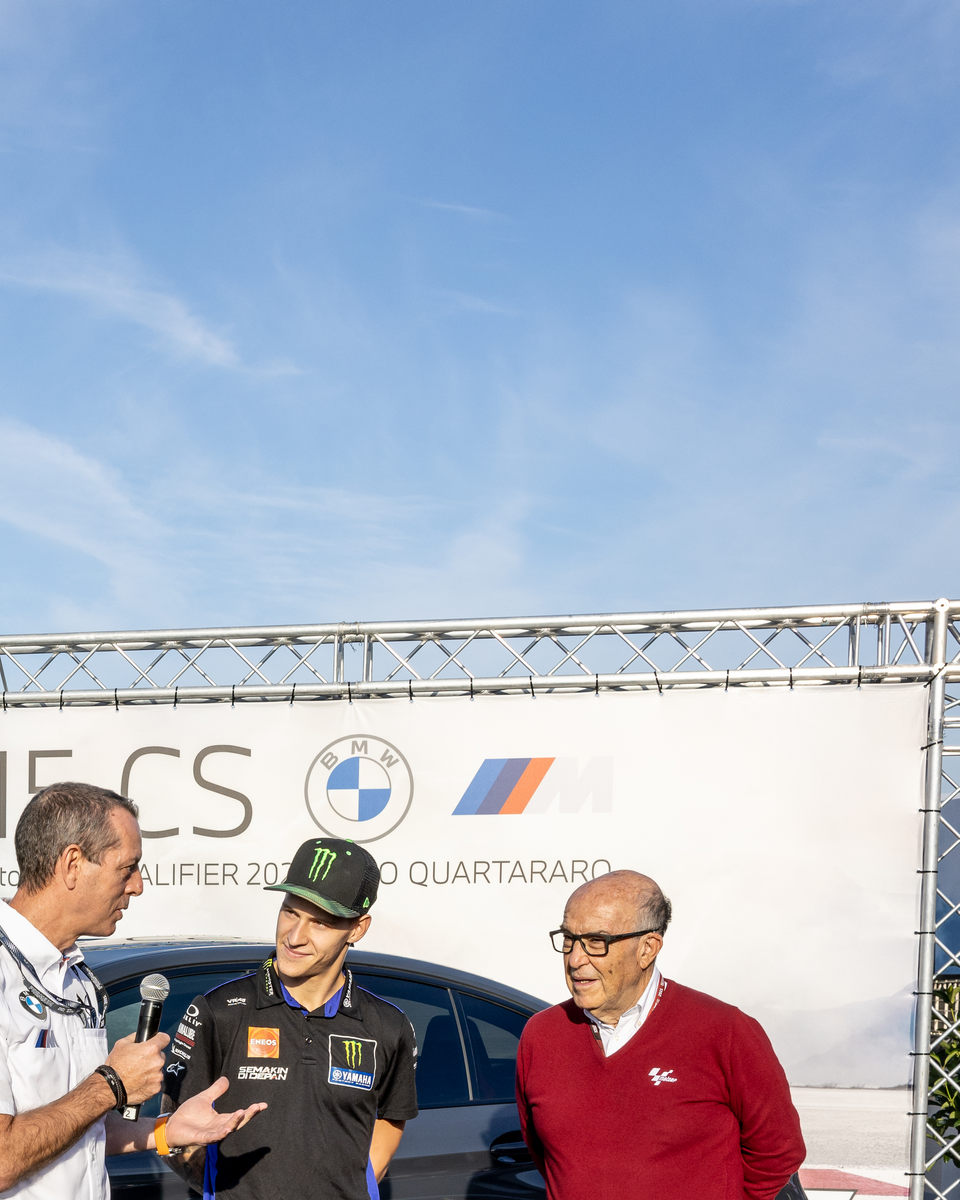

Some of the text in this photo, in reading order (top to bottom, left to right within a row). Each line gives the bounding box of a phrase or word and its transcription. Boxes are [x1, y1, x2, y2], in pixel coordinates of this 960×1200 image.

[120, 744, 253, 838] CS
[139, 862, 238, 886] ALIFIER
[246, 862, 291, 886] 20
[409, 859, 612, 886] QUARTARARO
[250, 1038, 277, 1046] ENEOS
[239, 1066, 288, 1074] SEMAKIN
[249, 1073, 287, 1081] DEPAN
[342, 1072, 371, 1085] YAMAHA
